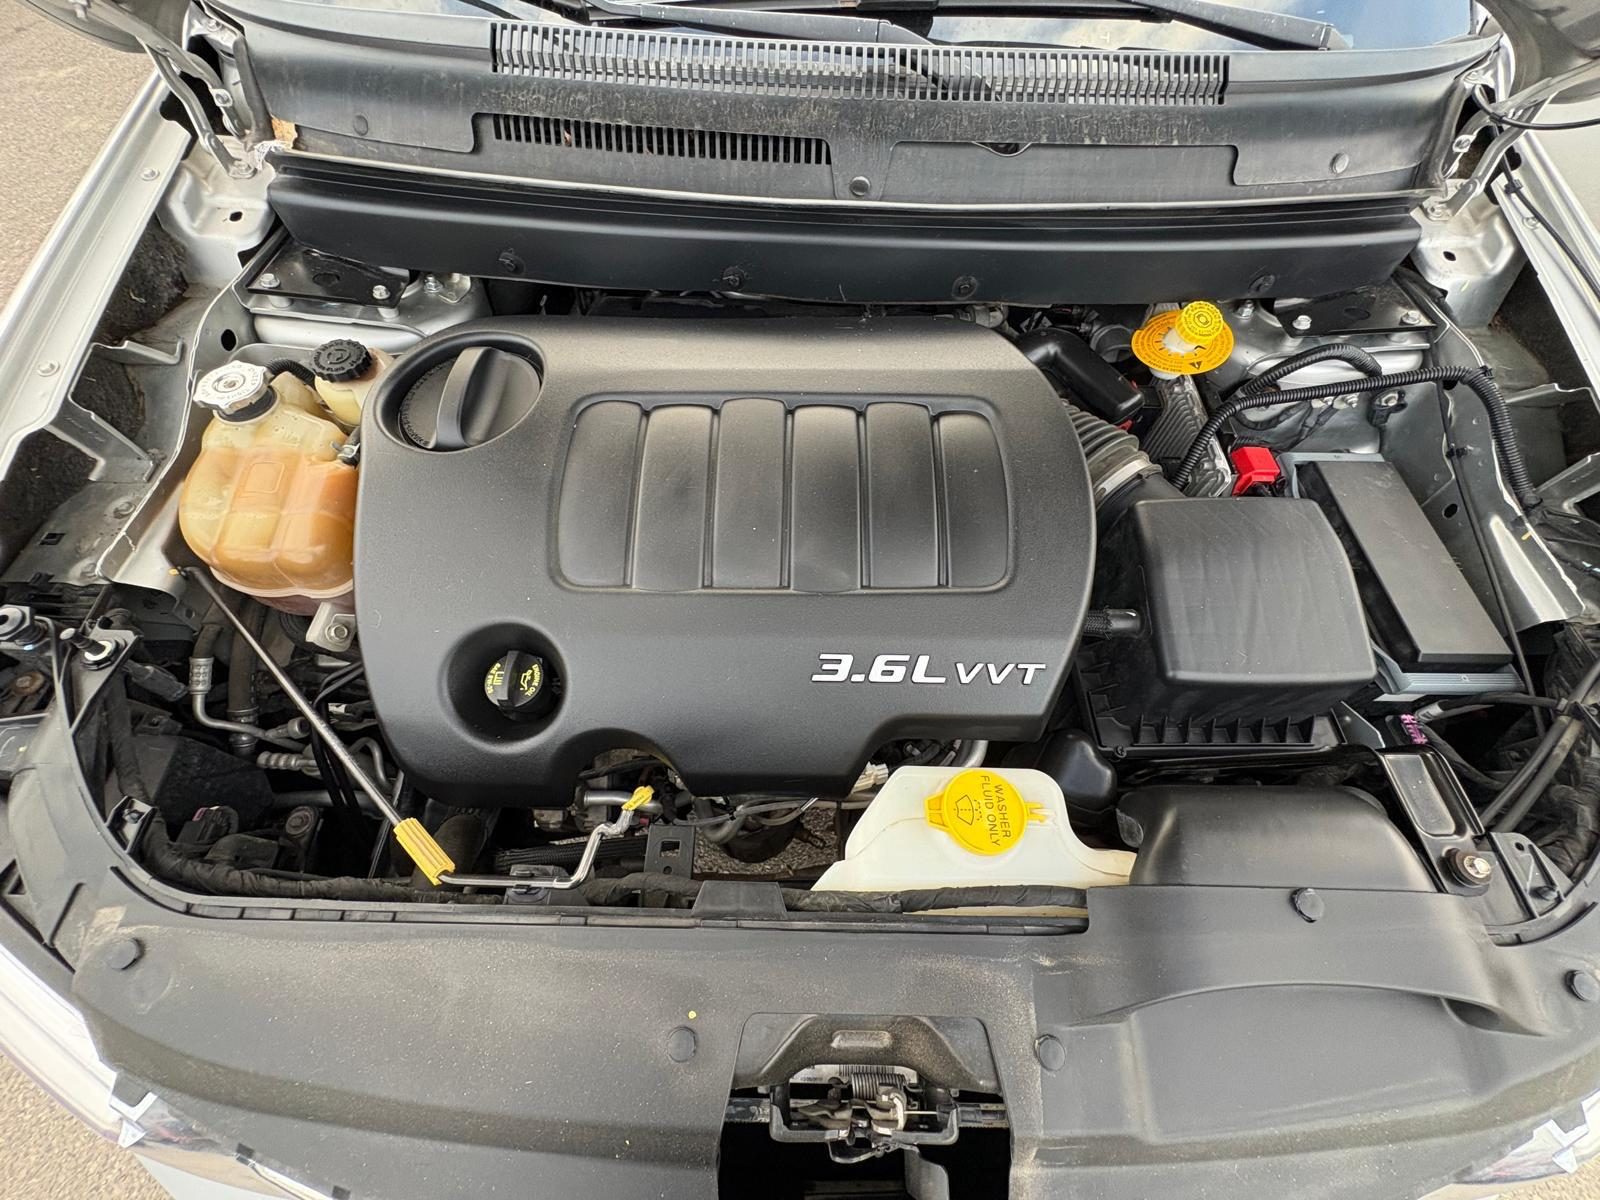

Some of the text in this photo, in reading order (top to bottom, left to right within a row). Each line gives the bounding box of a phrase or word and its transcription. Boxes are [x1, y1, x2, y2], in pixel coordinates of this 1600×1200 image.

[525, 664, 540, 697] ENGINE OIL
[811, 653, 1046, 685] 3.6L VVT
[981, 775, 1001, 847] FLUID ONLY
[994, 784, 1011, 837] WASHER
